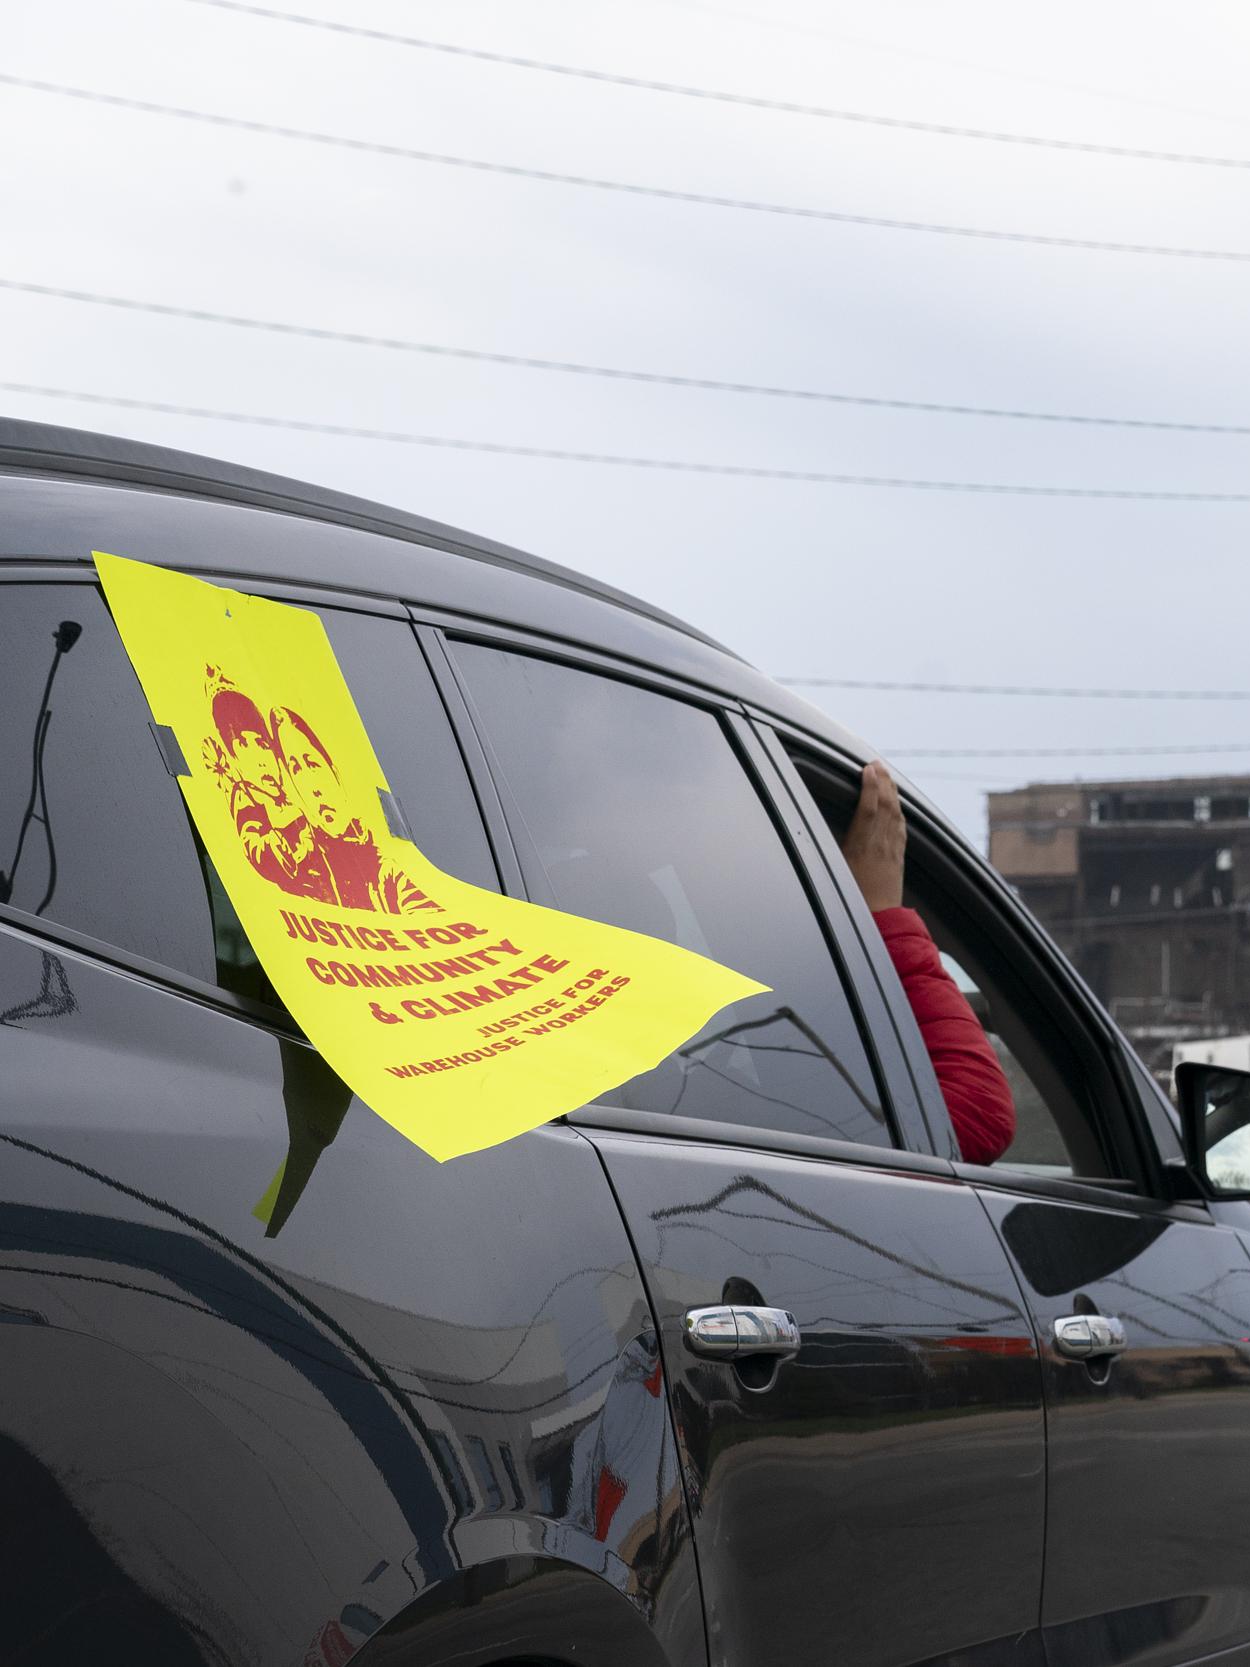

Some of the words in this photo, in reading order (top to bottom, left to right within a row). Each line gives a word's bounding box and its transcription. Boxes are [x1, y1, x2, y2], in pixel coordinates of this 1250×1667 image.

[279, 909, 409, 951] JUSTICE
[411, 922, 489, 949] FOR
[305, 938, 523, 988] COMMUNITY
[368, 1001, 404, 1024] &
[400, 954, 571, 1020] CLIMATE
[476, 998, 565, 1038] JUSTICE
[569, 968, 609, 999] FOR
[384, 1036, 526, 1078] WAREHOUSE
[523, 976, 631, 1035] WORKERS
